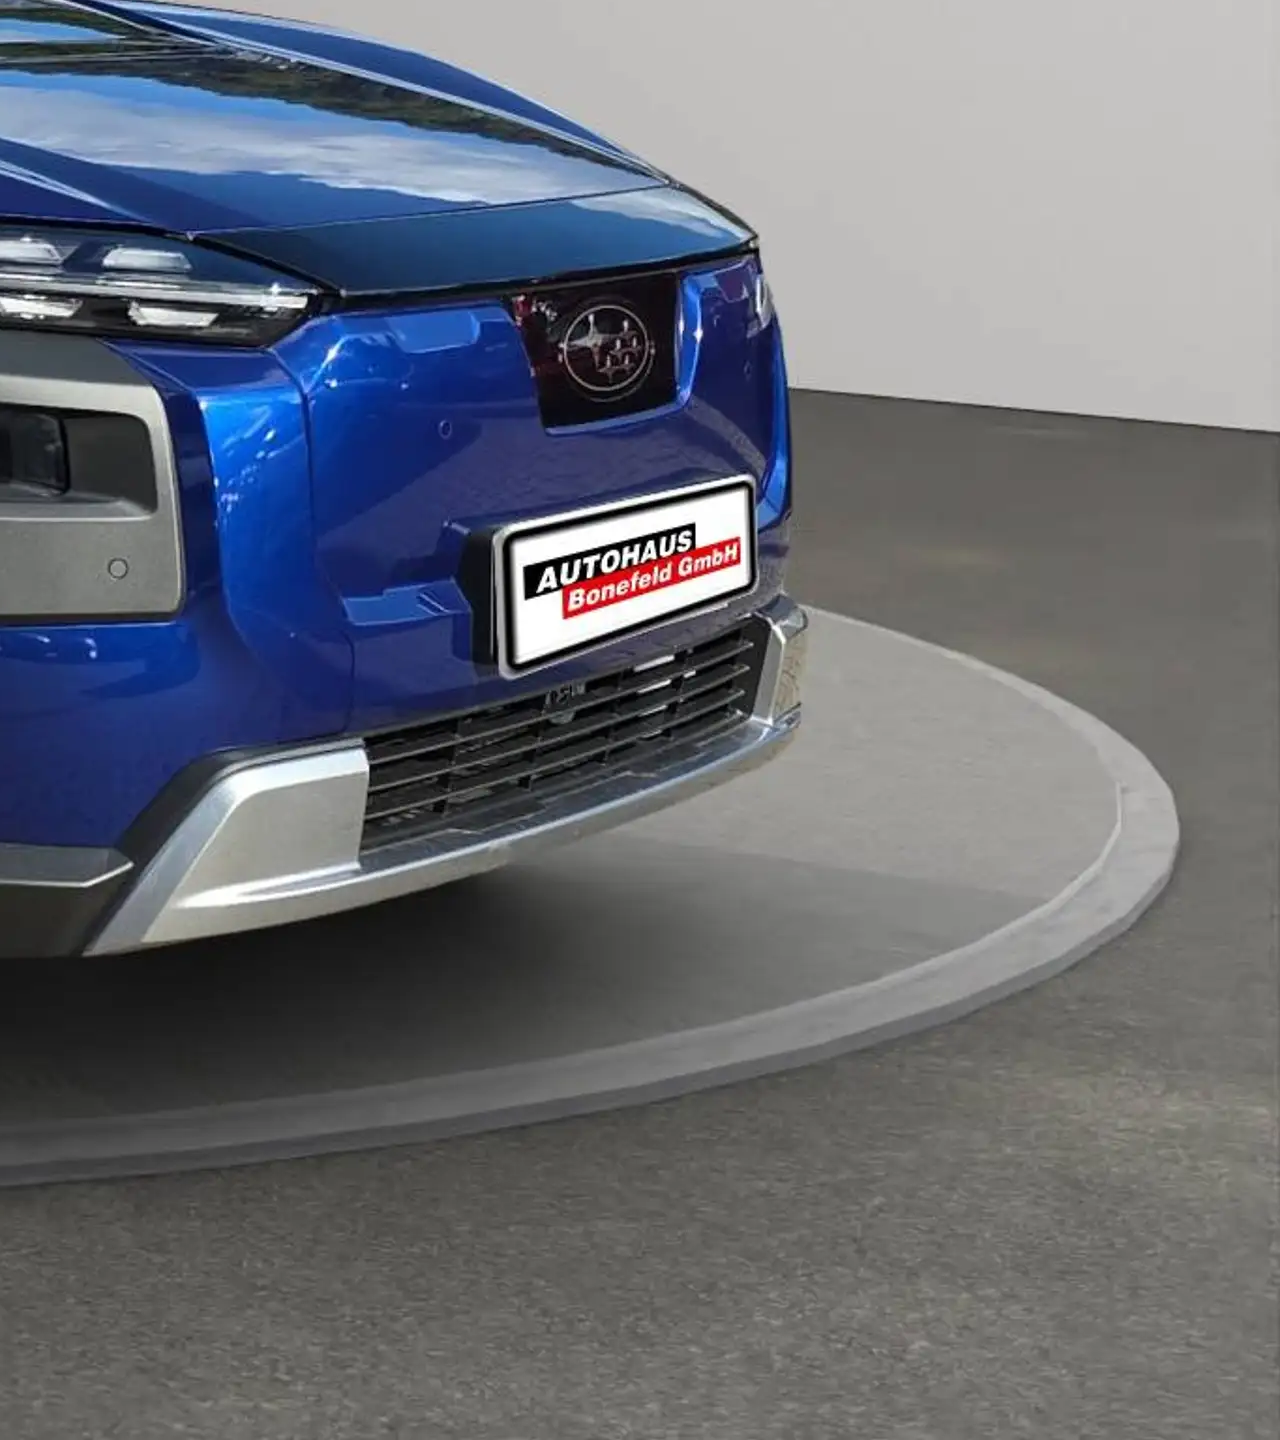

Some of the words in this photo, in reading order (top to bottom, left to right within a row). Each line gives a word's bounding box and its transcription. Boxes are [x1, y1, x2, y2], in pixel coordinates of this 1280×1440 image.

[536, 530, 693, 593] AUTOHAUS
[567, 563, 673, 610] Bonefeld
[678, 543, 738, 576] GmbH
